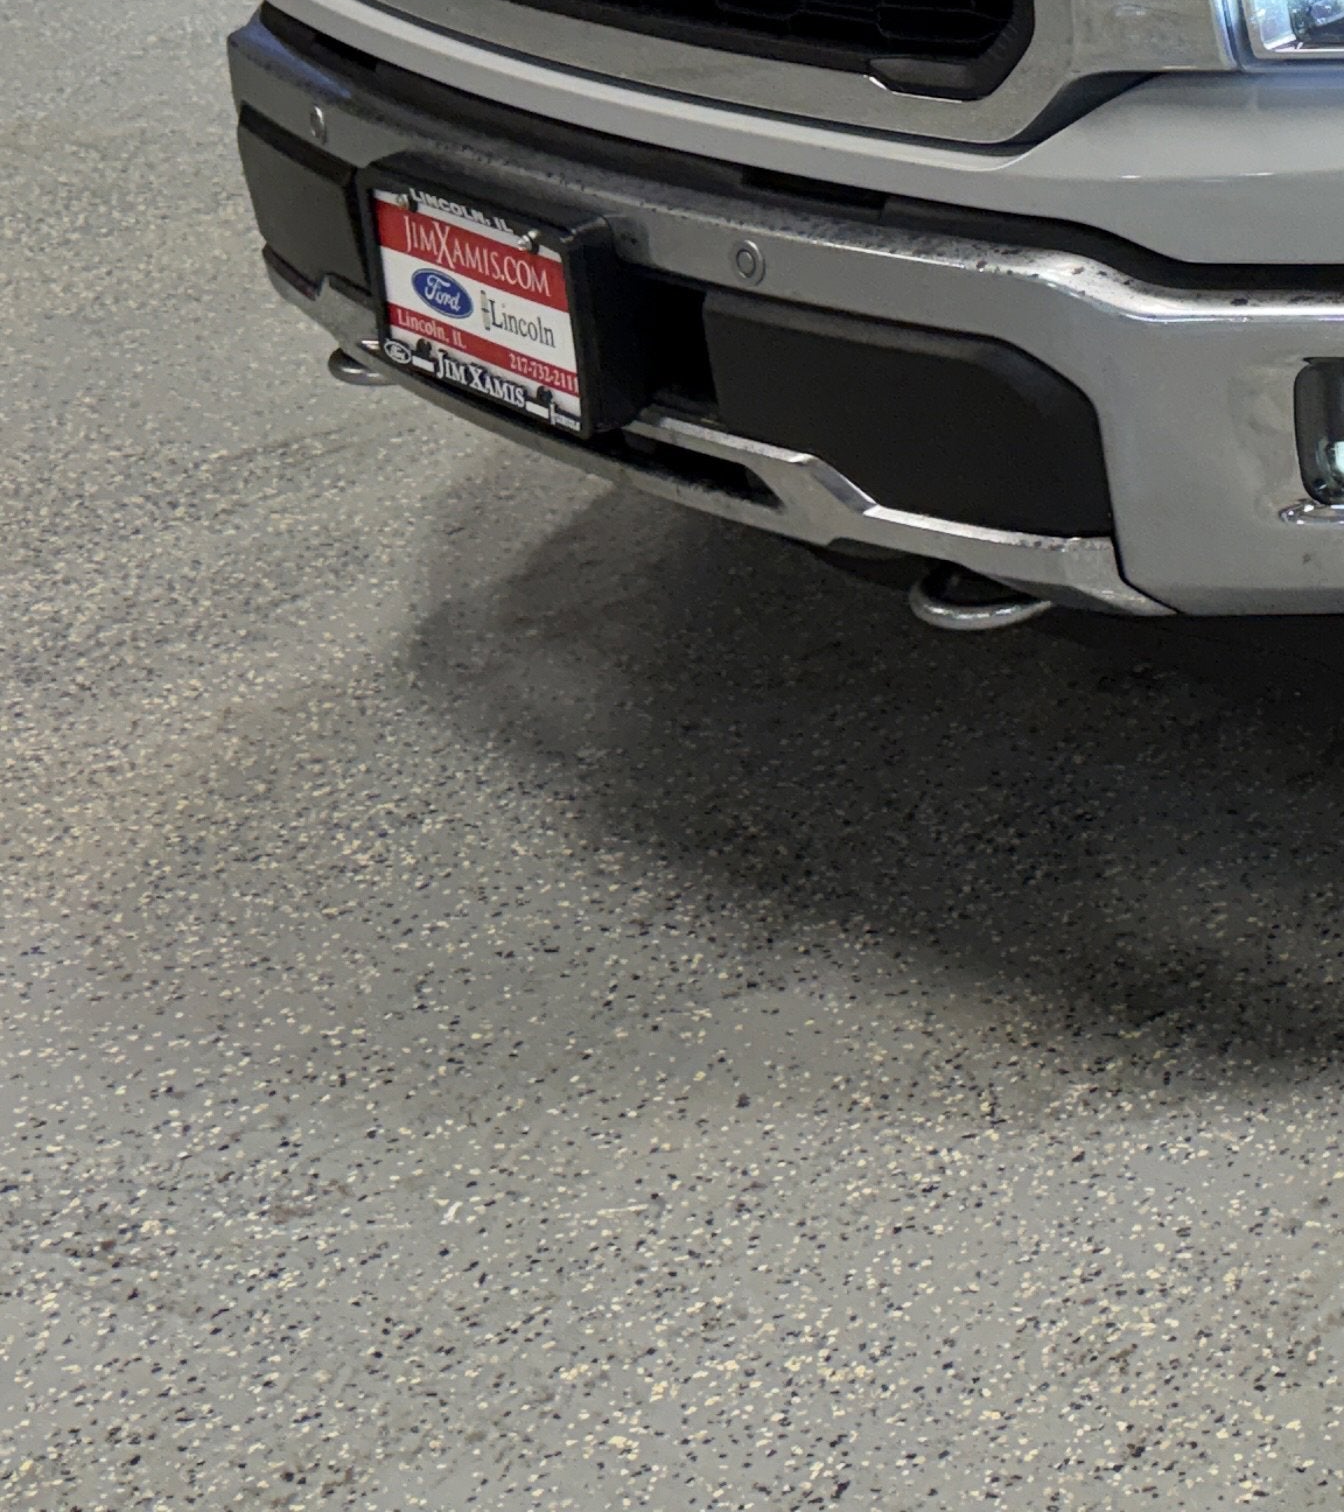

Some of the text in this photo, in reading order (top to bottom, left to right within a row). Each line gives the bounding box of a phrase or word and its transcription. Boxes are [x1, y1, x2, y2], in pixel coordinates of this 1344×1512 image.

[424, 274, 461, 312] Ford
[452, 332, 467, 350] IL
[489, 299, 556, 349] Lincoln
[436, 349, 469, 386] JIM
[469, 363, 526, 409] XAMIS
